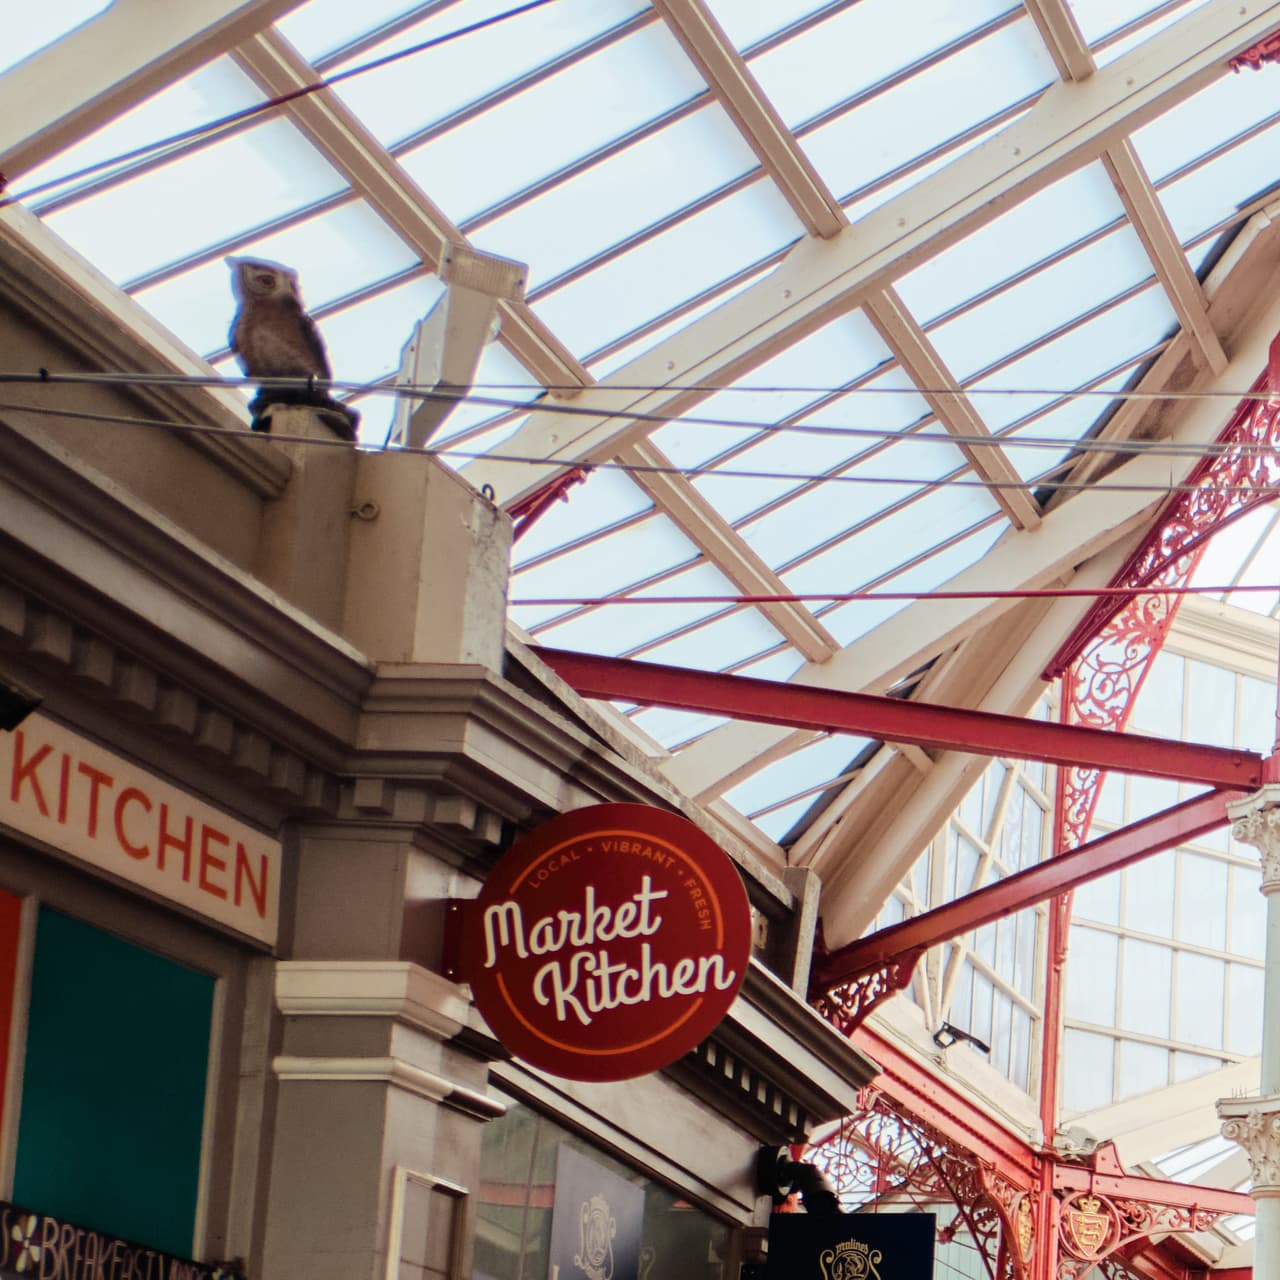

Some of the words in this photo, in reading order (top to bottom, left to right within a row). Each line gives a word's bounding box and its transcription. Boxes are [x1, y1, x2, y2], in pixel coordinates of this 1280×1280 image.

[10, 728, 269, 920] KITCHEN
[483, 874, 669, 969] Market
[528, 851, 581, 890] LOCAL
[600, 840, 677, 870] VIBRANT
[683, 877, 712, 931] FRESH
[532, 941, 737, 1026] Kitchen
